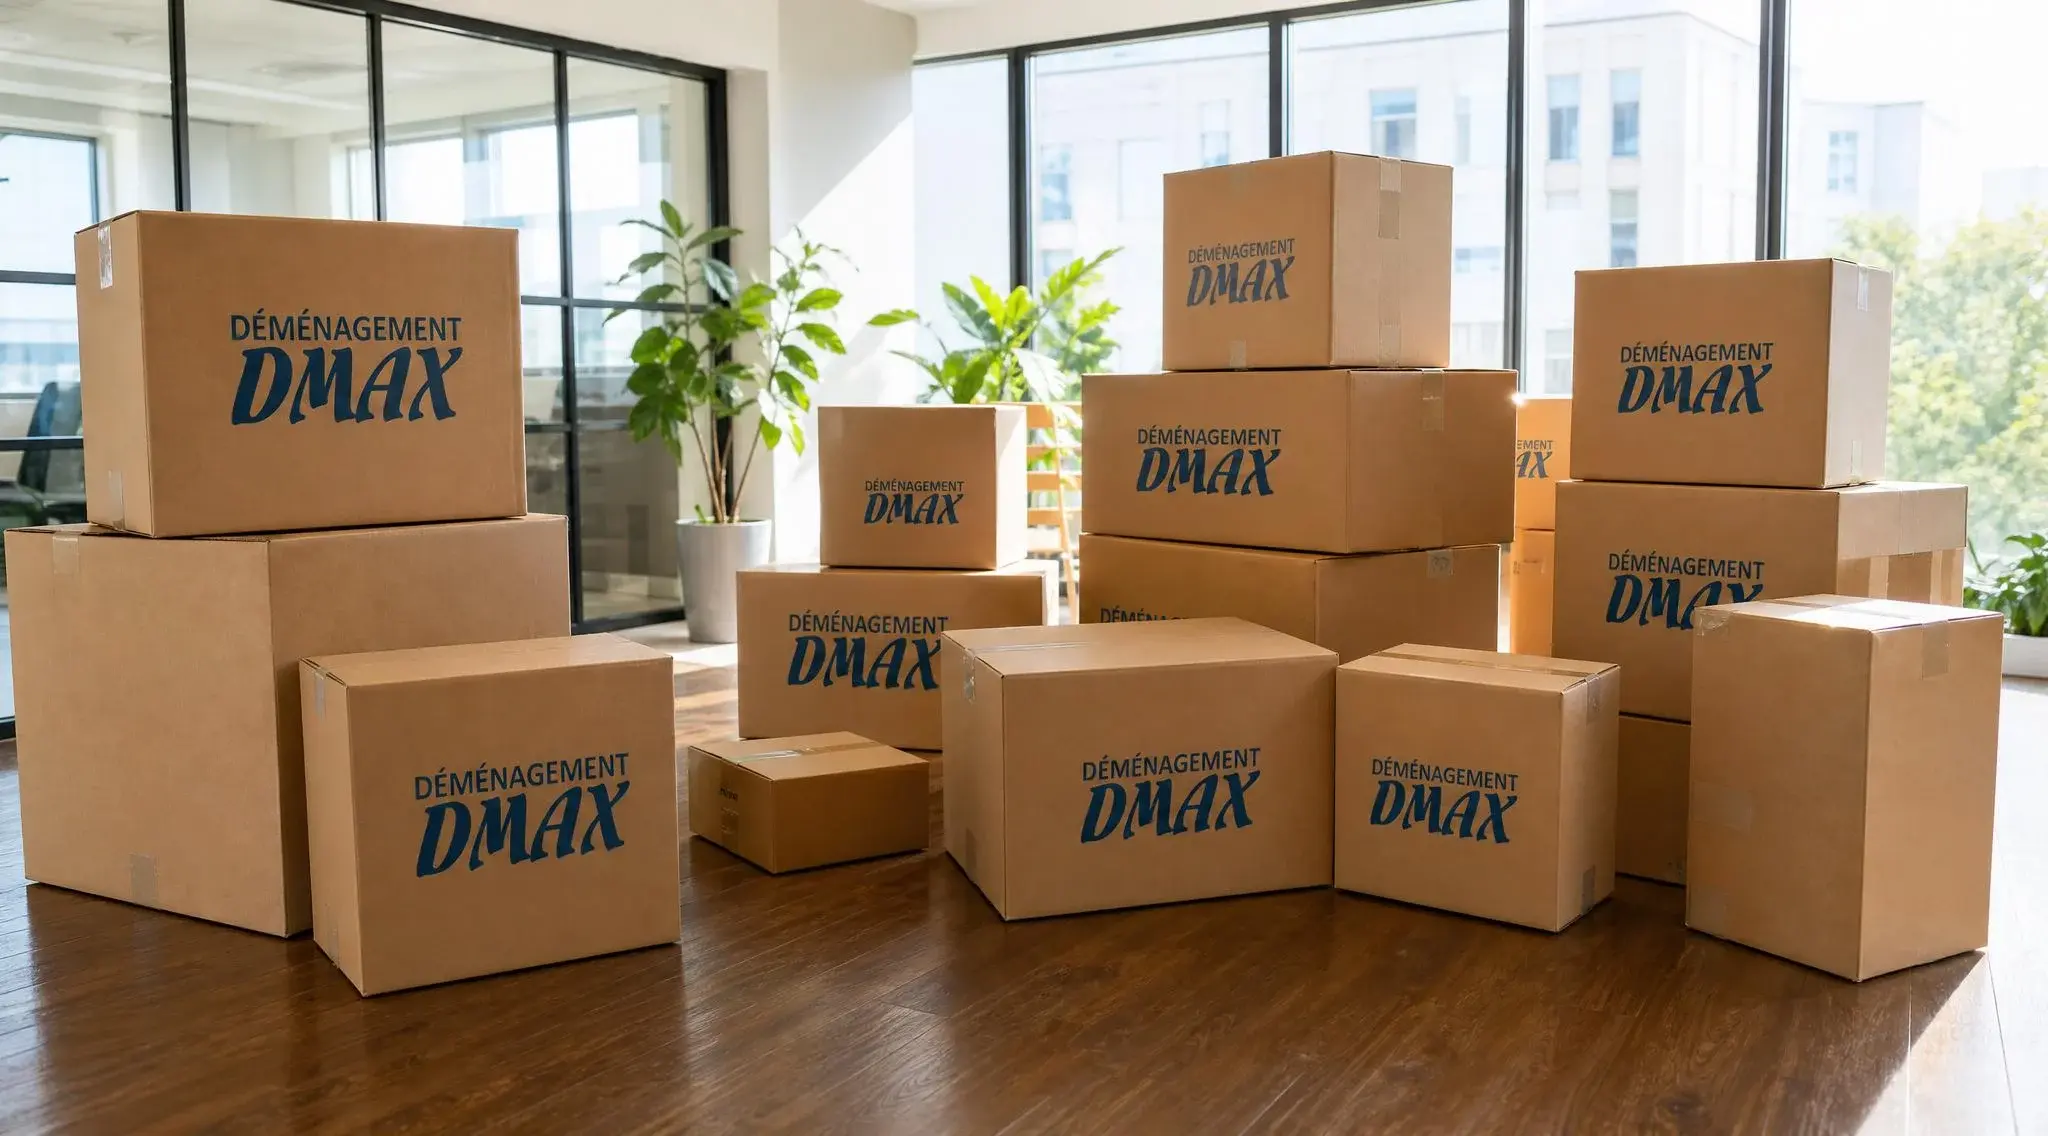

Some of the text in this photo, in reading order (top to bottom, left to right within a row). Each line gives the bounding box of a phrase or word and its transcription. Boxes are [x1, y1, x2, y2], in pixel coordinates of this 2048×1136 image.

[1188, 238, 1295, 263] DÉMÉNAGEMENT
[1187, 255, 1295, 307] DMAX
[230, 308, 462, 341] DÉMÉNAGEMENT
[1620, 341, 1774, 363] DÉMÉNAGEMENT
[231, 346, 463, 425] DMAX
[1618, 364, 1772, 414] DMAX
[1137, 425, 1281, 446] DÉMÉNAGEMENT
[1136, 447, 1281, 496] DMAX
[1516, 451, 1552, 478] AX
[865, 478, 965, 492] DÉMÉNAGEMENT
[863, 493, 964, 524] DMAX
[1608, 549, 1765, 580] DÉMÉNAGEMENT
[789, 609, 948, 634] DÉMÉNAGEMENT
[787, 635, 941, 691] DMAX
[415, 752, 629, 800] DÉMÉNAGEMENT
[1082, 747, 1261, 782] DÉMÉNAGEMENT
[1371, 756, 1519, 792] DÉMÉNAGEMENT
[1081, 770, 1261, 843] DMAX
[1370, 779, 1518, 843] DMAX
[416, 780, 630, 878] DMAX
